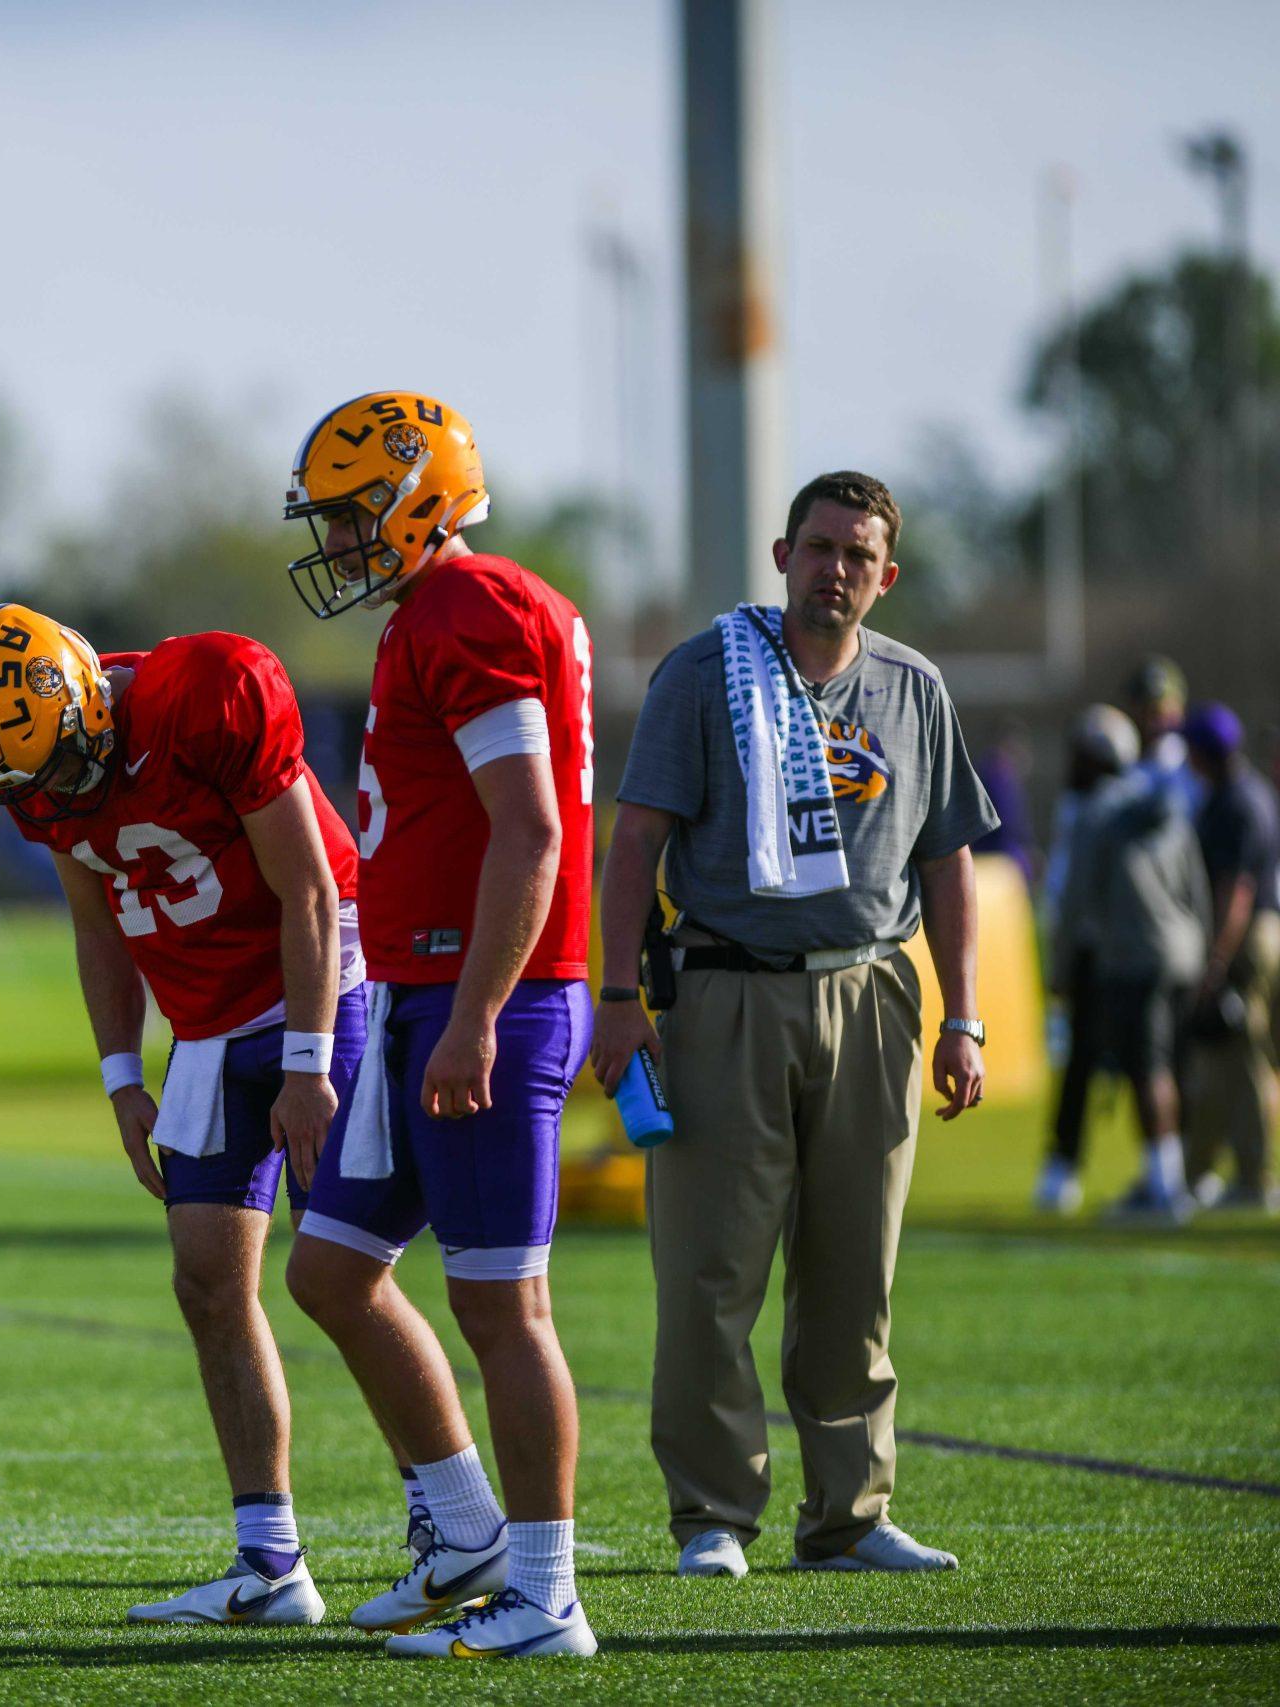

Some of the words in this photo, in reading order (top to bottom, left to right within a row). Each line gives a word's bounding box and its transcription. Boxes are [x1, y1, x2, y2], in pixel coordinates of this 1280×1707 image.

[336, 398, 443, 448] LSU
[358, 705, 388, 860] 5
[72, 822, 223, 937] 13
[641, 1049, 668, 1108] WERADE
